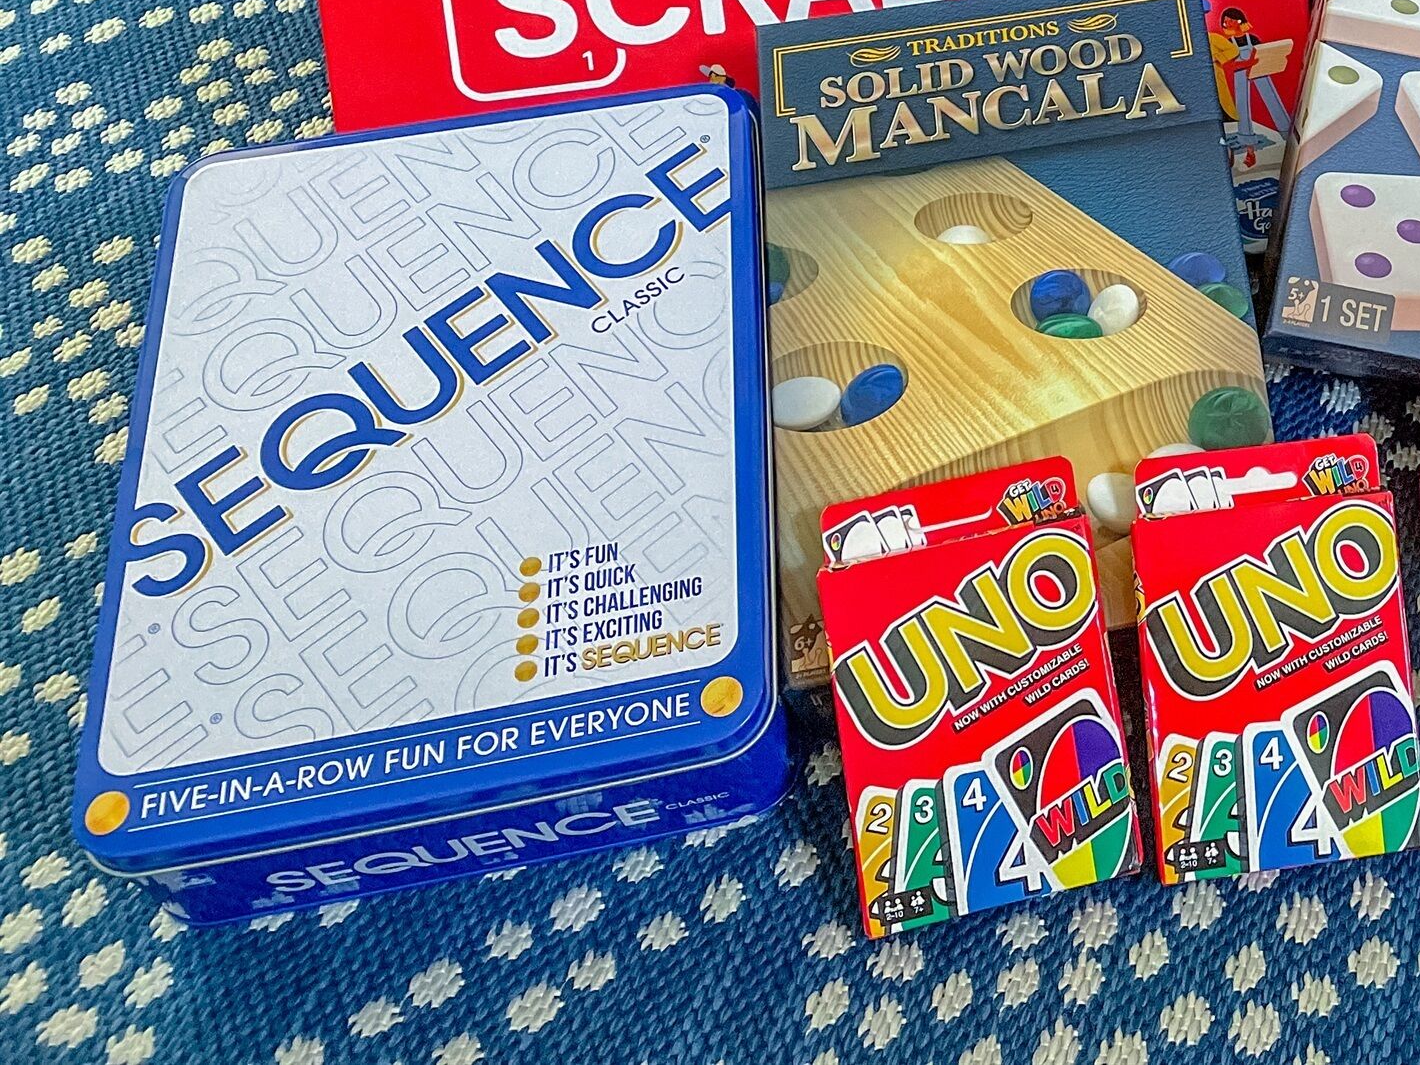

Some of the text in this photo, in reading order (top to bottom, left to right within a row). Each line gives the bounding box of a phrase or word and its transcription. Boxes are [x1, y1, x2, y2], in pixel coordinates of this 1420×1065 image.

[907, 20, 1060, 57] TRADITIONS
[581, 50, 595, 70] 1
[820, 33, 1143, 109] SOLID WOOD
[789, 63, 1185, 171] MANCALA
[590, 266, 686, 334] CLASSIC
[1288, 287, 1305, 300] 5+
[1320, 295, 1388, 333] 1 SET
[126, 142, 733, 599] SEQUENCE
[1314, 455, 1336, 471] GET
[1009, 481, 1031, 497] GET
[548, 542, 618, 572] IT'S FUN
[546, 576, 702, 624] IT'S CHALLENGING
[547, 564, 636, 599] IT'S QUICK
[1150, 502, 1399, 696] UNO
[545, 610, 663, 650] IT'S EXCITING
[794, 636, 813, 651] 6+
[838, 530, 1099, 747] UNO
[544, 623, 722, 677] IT'S SEQUENCE
[1256, 616, 1383, 689] NOW WITH CUSTOMIZABLE
[1324, 631, 1389, 671] WILD CARDS!
[954, 643, 1083, 731] NOW WITH CUSTOMIZABLE
[1024, 658, 1090, 705] WILD CARDS!
[140, 694, 691, 820] FIVE-IN-A-ROW FUN FOR EVERYONE
[1166, 752, 1193, 783] 2
[1213, 749, 1233, 777] 3
[1260, 737, 1284, 771] 4
[962, 777, 987, 811] 4
[1329, 736, 1420, 814] WILD
[867, 802, 893, 834] 2
[914, 796, 935, 824] 3
[1035, 762, 1131, 847] WILD
[266, 791, 730, 893] SEQUENCE CLASSIC
[1180, 860, 1198, 869] 2-10
[886, 909, 905, 920] 2-10
